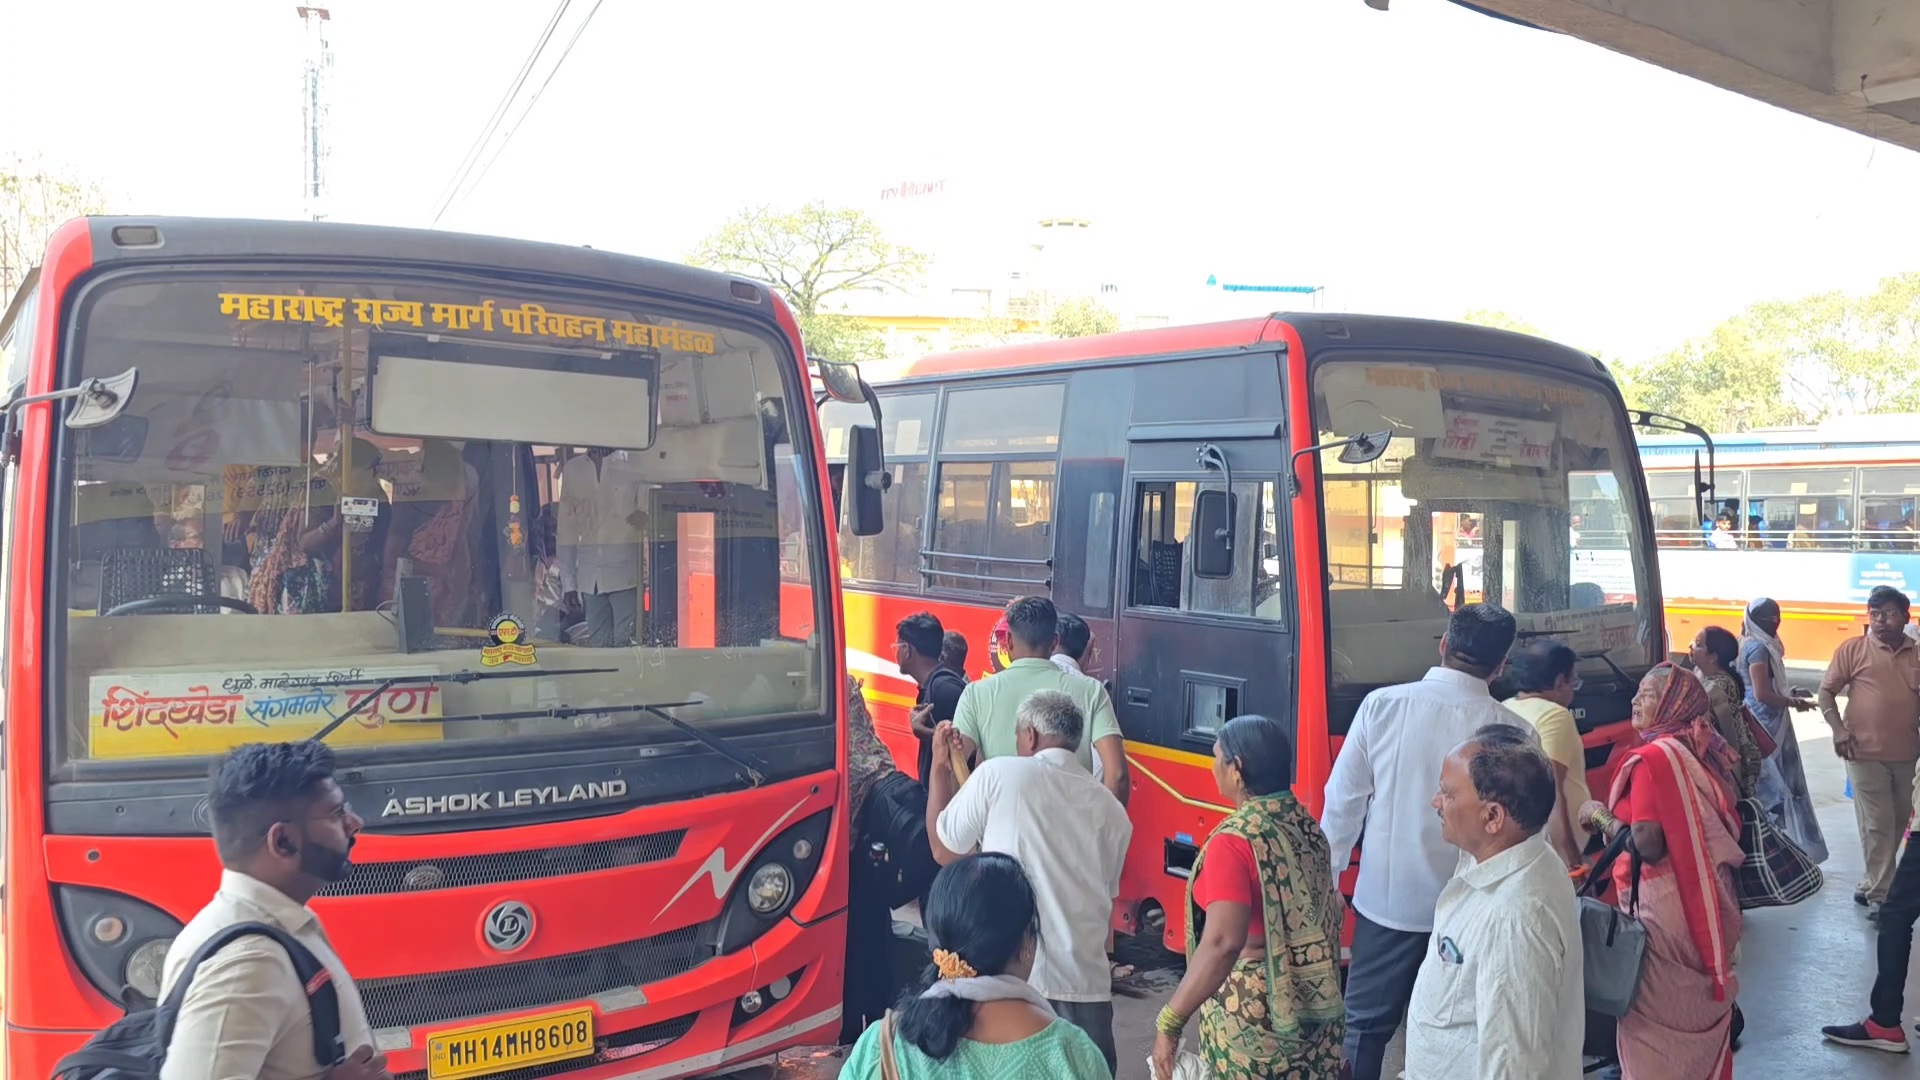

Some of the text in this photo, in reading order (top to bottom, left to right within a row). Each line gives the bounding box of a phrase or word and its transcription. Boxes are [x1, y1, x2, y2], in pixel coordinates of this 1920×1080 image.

[218, 293, 715, 355] महाराष्ट्र राज्य मार्ग परिवहन महामंडळ
[102, 685, 244, 739] शिंदखेडा
[245, 687, 337, 728] संगमनेर
[382, 779, 627, 817] ASHOK LEYLAND
[449, 1019, 588, 1067] MH14MH8608
